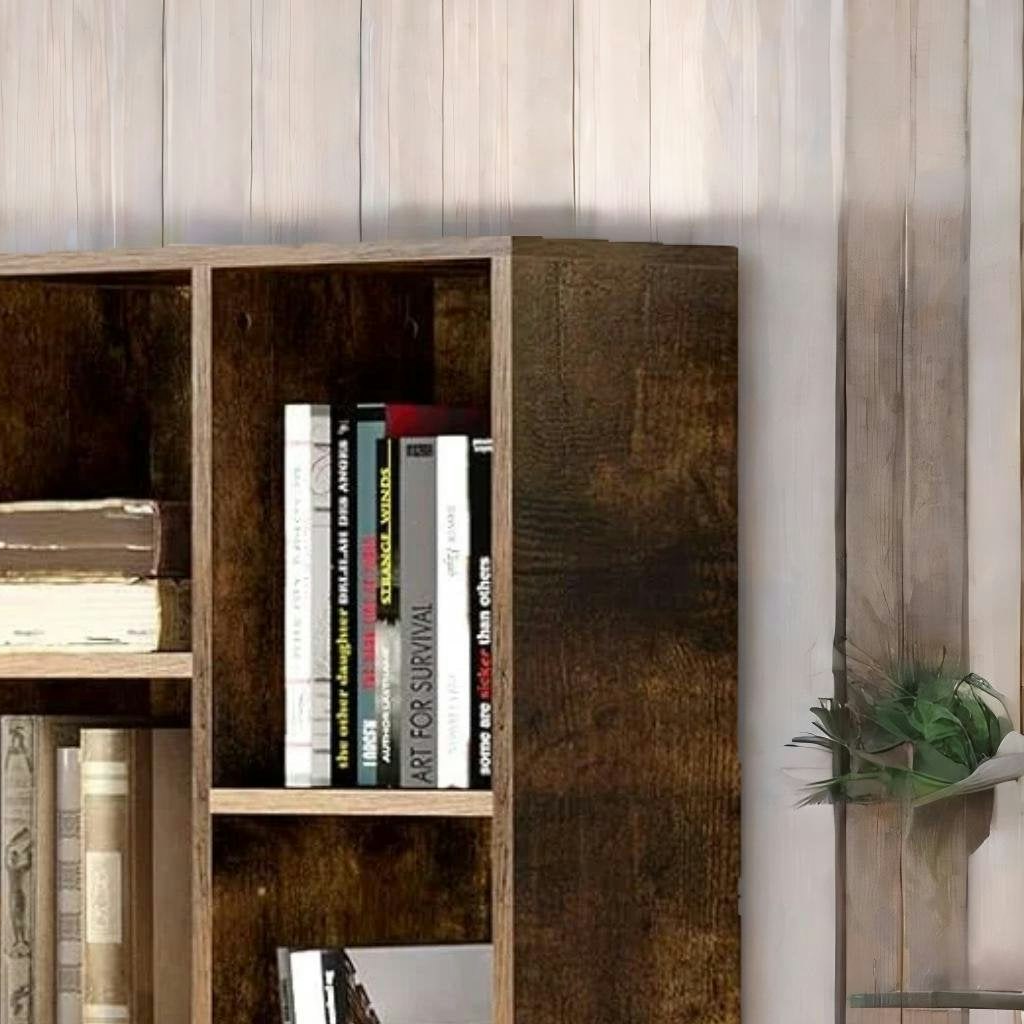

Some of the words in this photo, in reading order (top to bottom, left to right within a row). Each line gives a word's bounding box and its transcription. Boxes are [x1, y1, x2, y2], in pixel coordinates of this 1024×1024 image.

[380, 467, 392, 525] WINDS
[338, 531, 349, 605] DELILAH
[380, 533, 392, 606] STRANGE
[476, 556, 491, 607] others
[336, 607, 352, 686] daughter
[410, 603, 433, 693] SURVIVAL
[476, 610, 491, 645] than
[476, 649, 491, 699] sicker
[336, 689, 349, 737] other
[410, 699, 433, 739] FOR
[479, 702, 491, 728] are
[336, 740, 349, 769] the
[411, 749, 433, 785] ART
[479, 731, 491, 776] some
